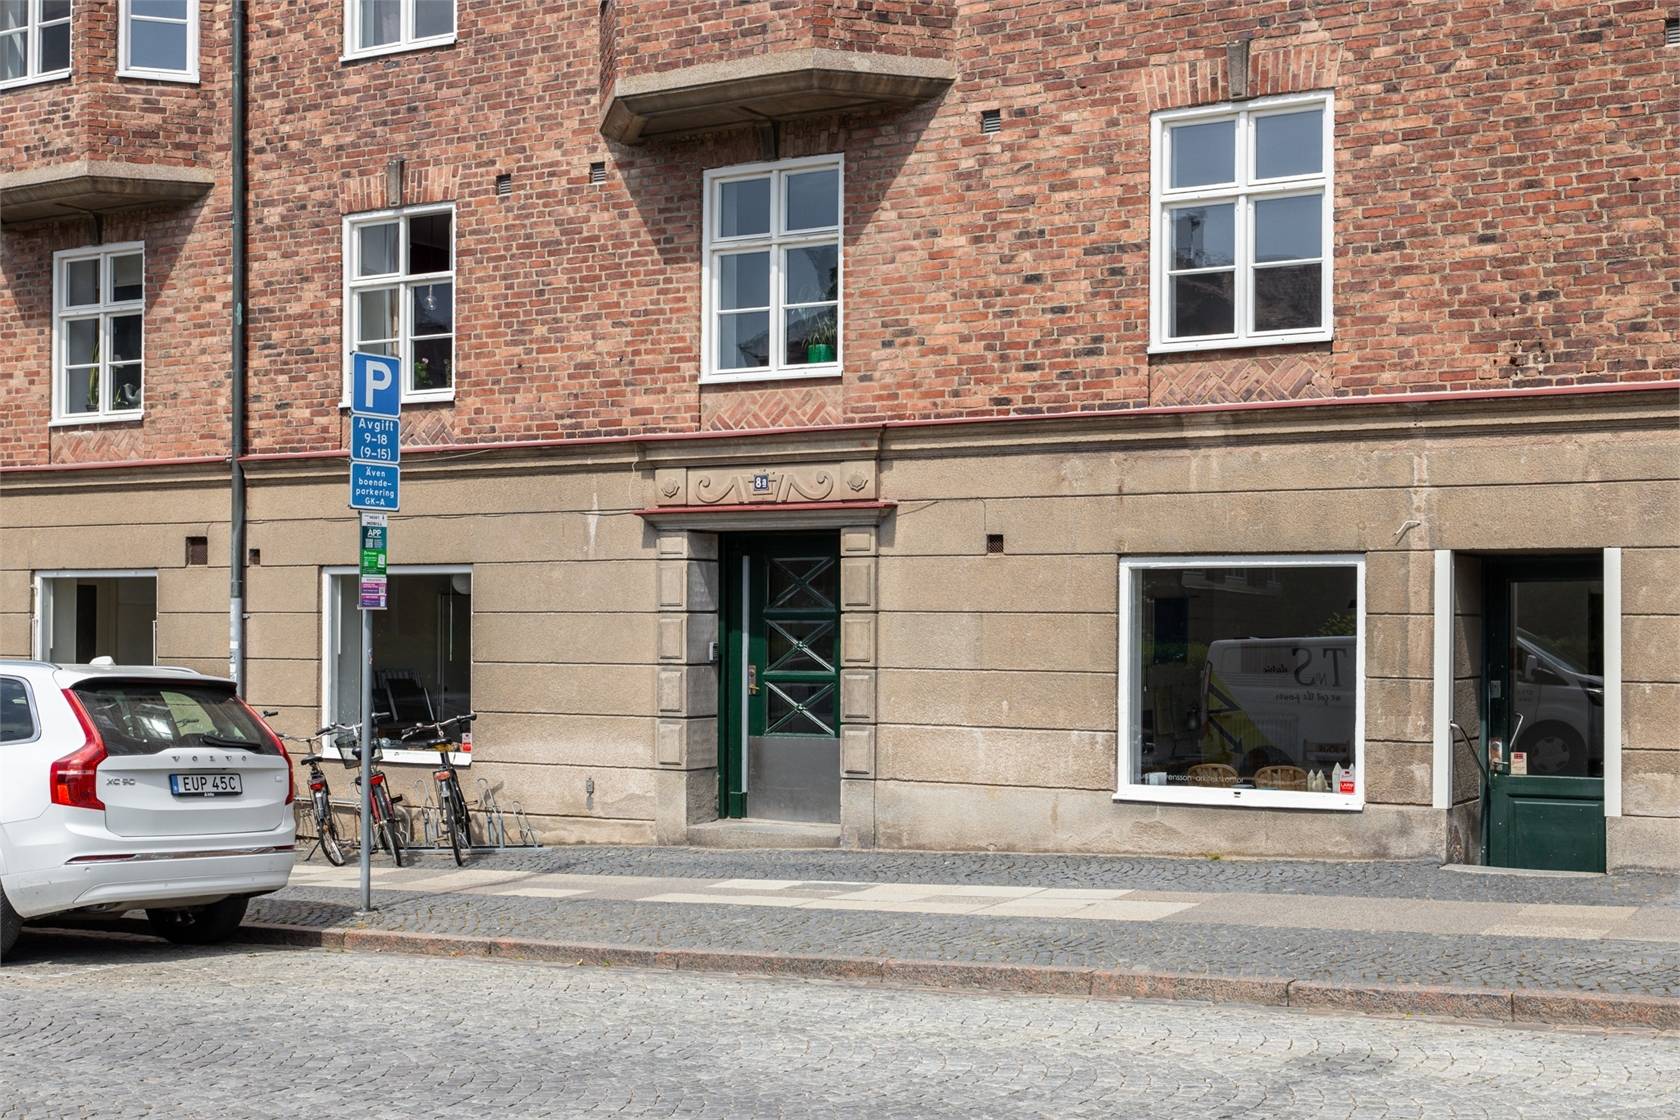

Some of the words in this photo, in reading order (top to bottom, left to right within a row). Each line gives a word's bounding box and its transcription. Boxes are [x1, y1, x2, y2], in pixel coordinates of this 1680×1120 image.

[365, 360, 391, 407] P
[358, 418, 393, 432] Avgift
[364, 434, 388, 445] 9-18
[360, 446, 391, 460] (9-15)
[365, 466, 385, 477] Även
[358, 478, 392, 488] boende-
[355, 487, 395, 499] parkering
[364, 497, 386, 506] GK-A
[367, 528, 382, 538] APP
[182, 776, 208, 792] EUP
[212, 776, 236, 791] 45C
